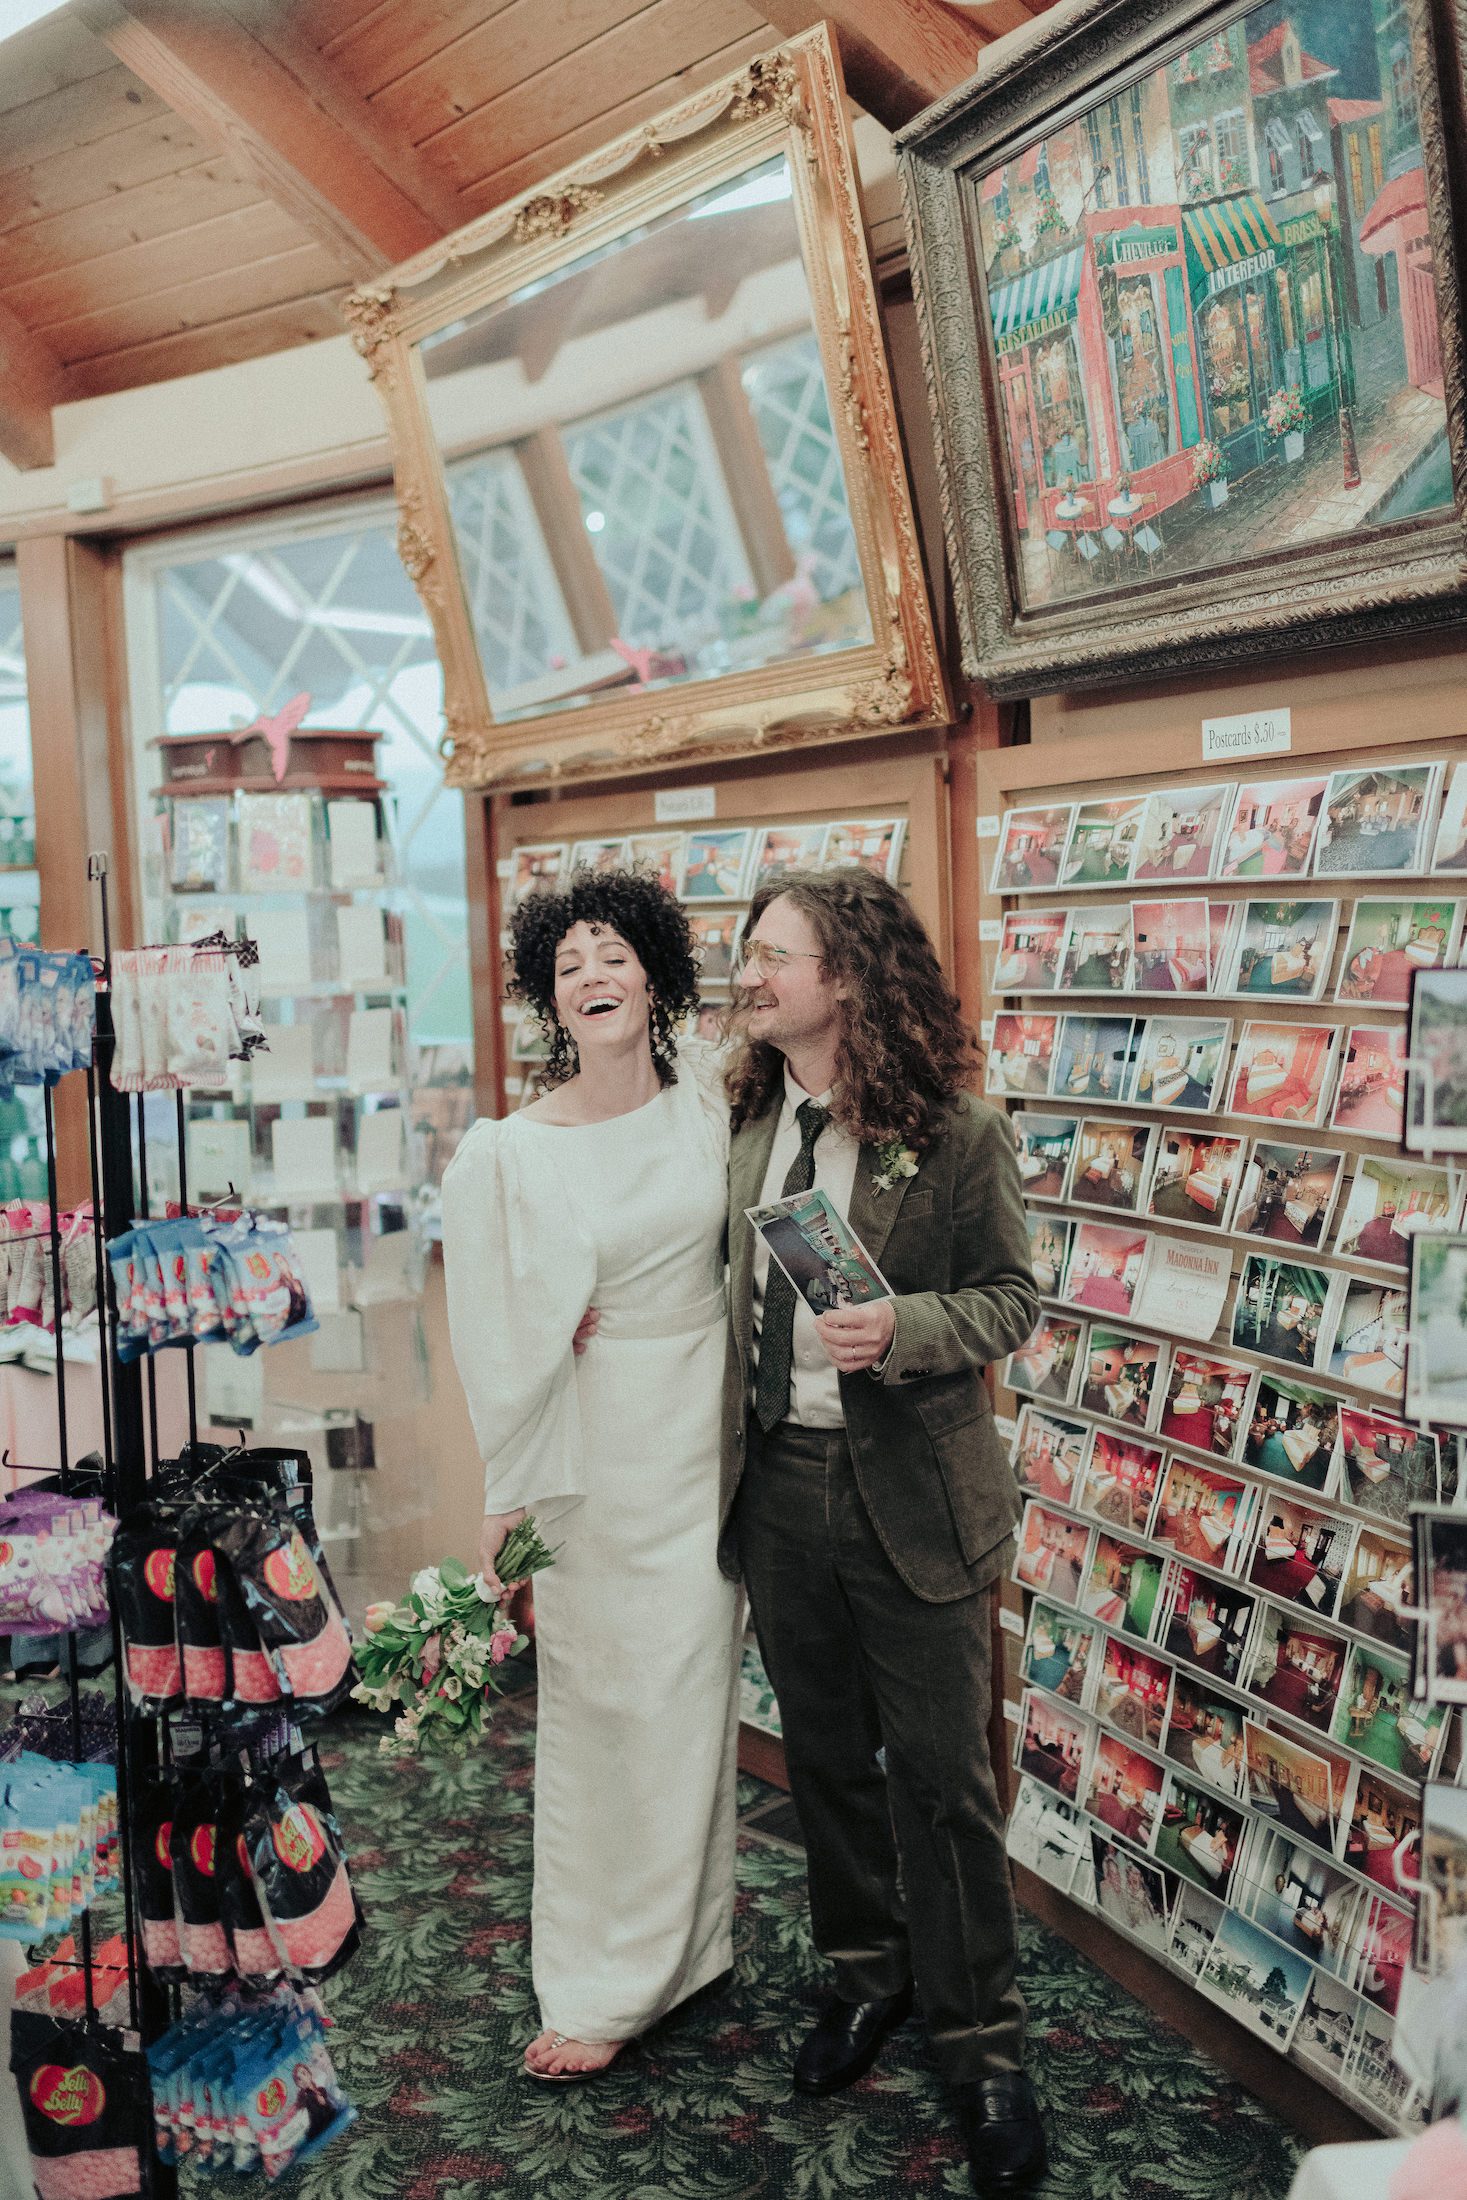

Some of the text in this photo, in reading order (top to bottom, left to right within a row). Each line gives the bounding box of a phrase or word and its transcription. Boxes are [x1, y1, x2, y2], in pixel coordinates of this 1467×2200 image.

[1209, 249, 1276, 294] INTERFLOR
[1208, 721, 1275, 750] Postcards $.50
[1166, 1249, 1203, 1273] MADONNA
[58, 2072, 90, 2097] Jelly
[43, 2090, 84, 2112] Belly
